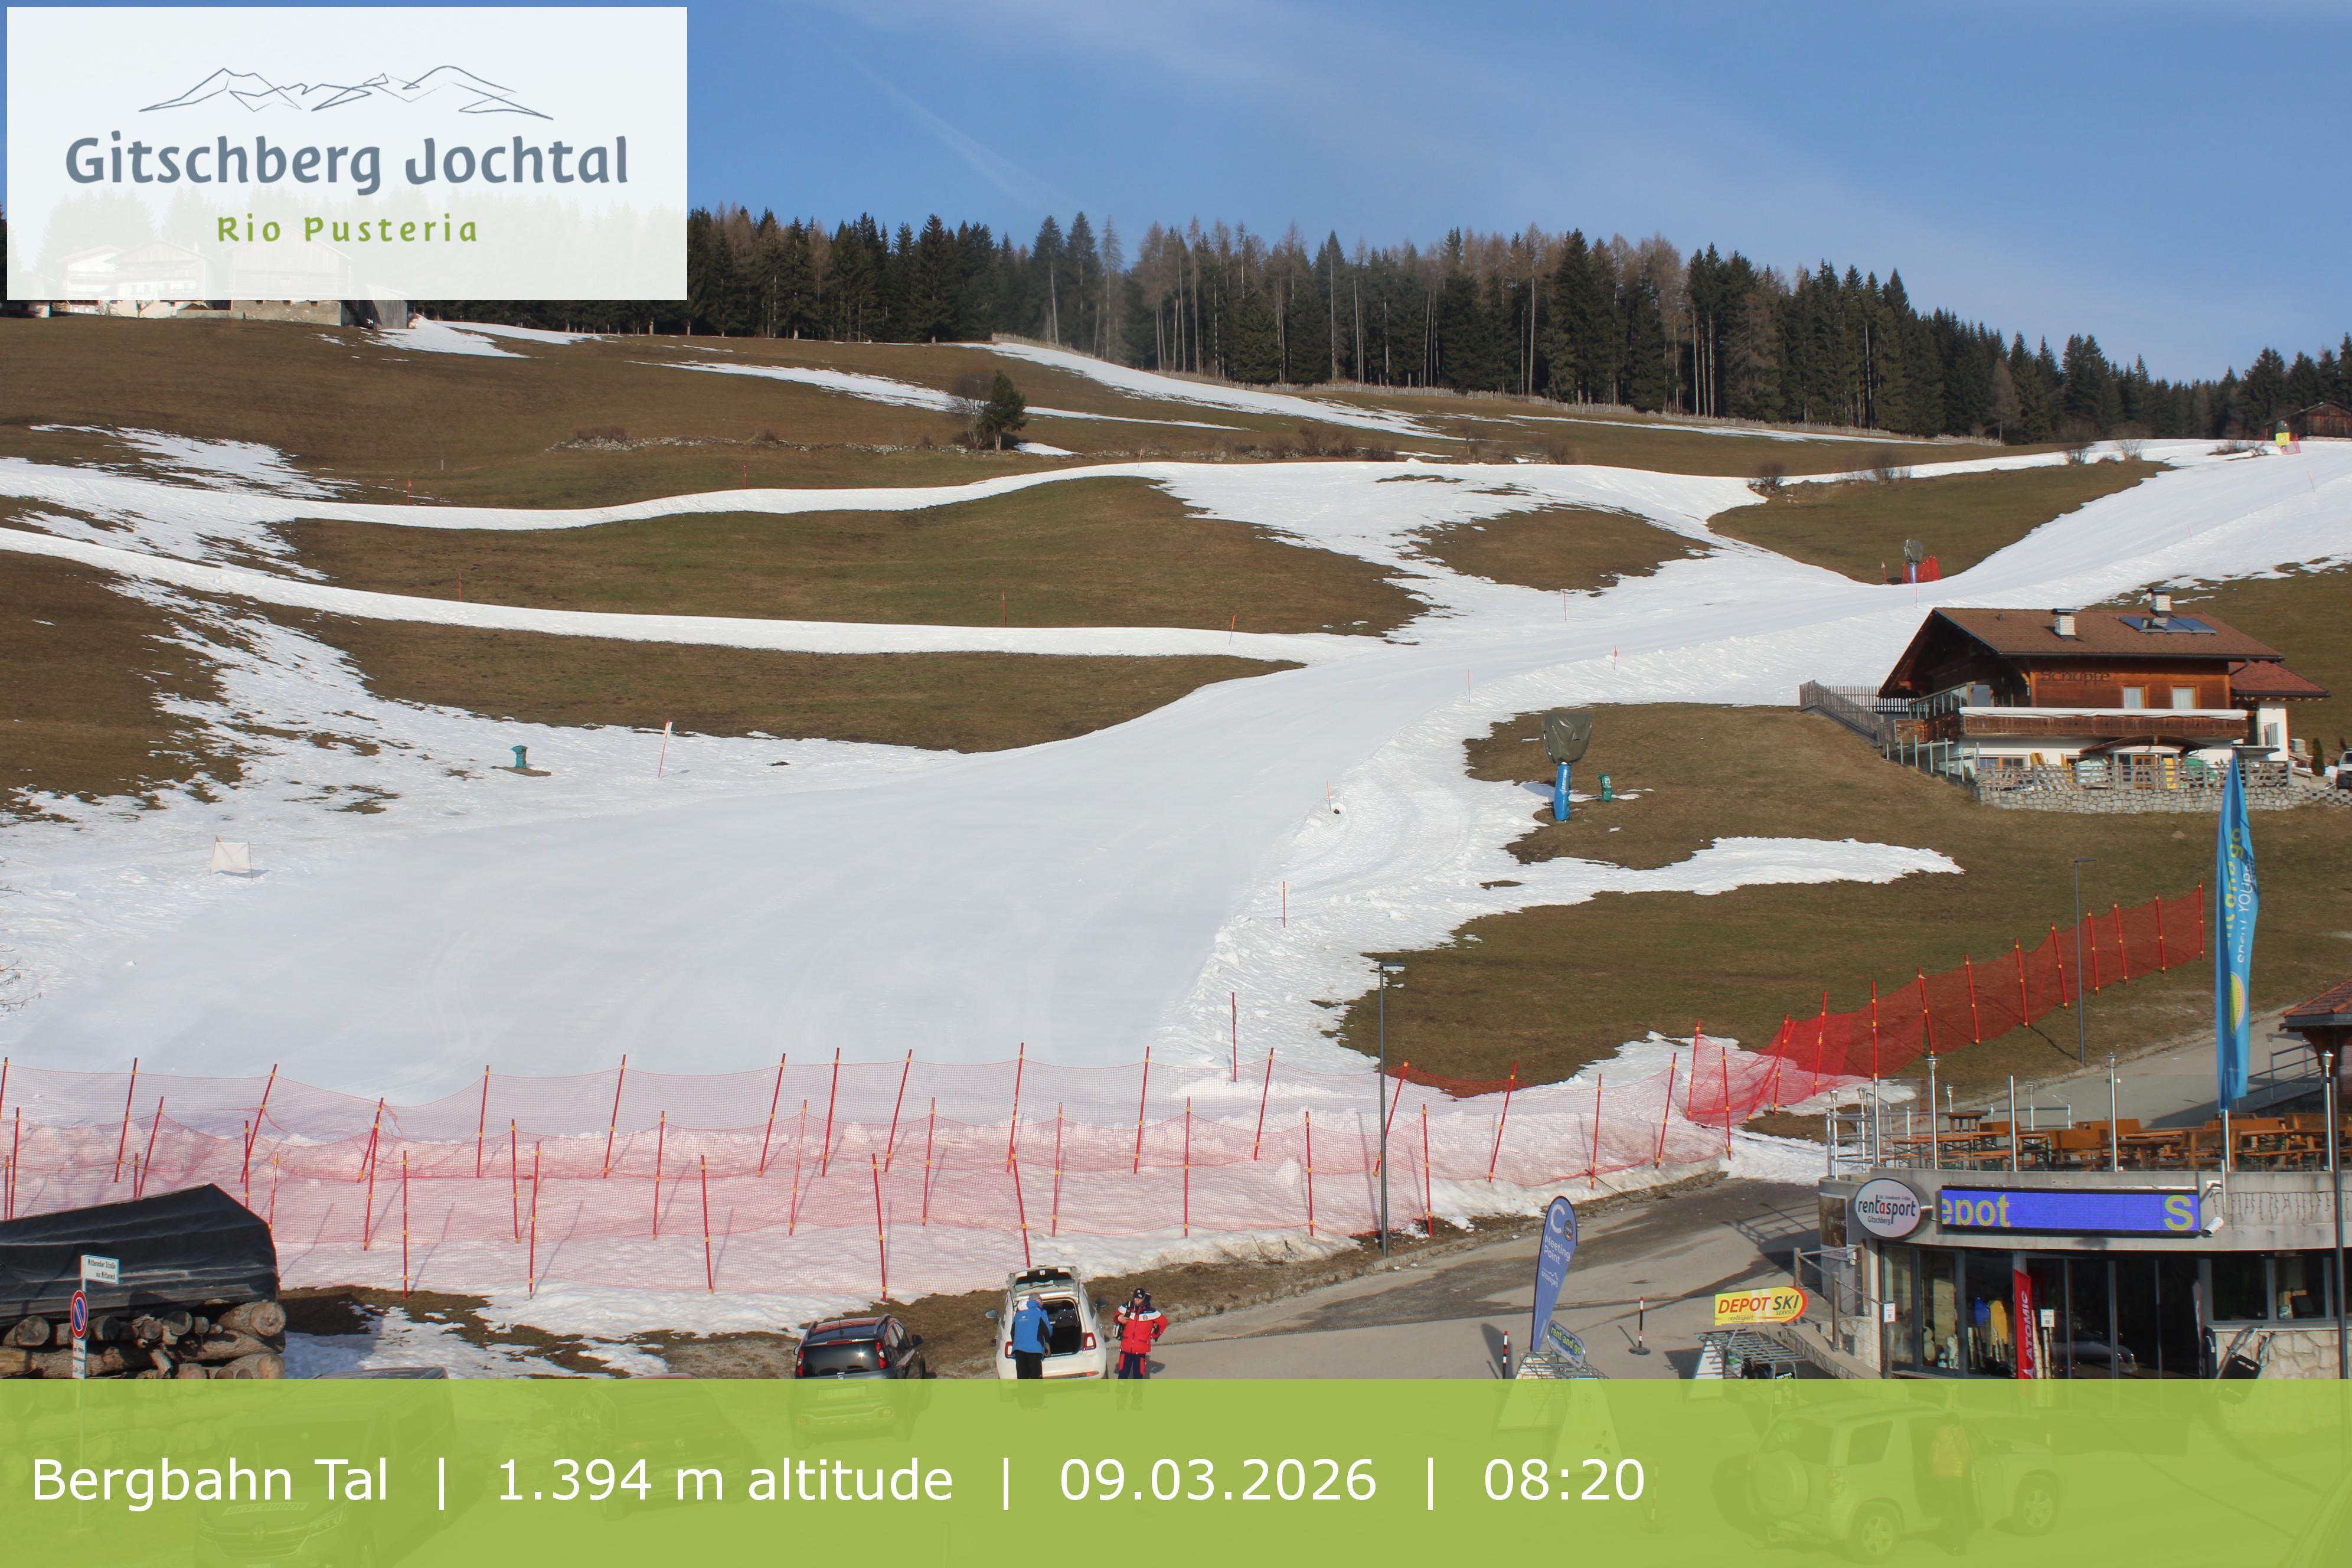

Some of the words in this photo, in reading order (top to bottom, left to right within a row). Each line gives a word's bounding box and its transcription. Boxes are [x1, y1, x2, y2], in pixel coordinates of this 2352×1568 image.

[1858, 1194, 1916, 1224] rentasport
[1867, 1216, 1891, 1226] Gitschberg
[2163, 1195, 2194, 1231] S
[1544, 1236, 1571, 1262] Meeting
[1544, 1245, 1560, 1265] Point
[1718, 1296, 1771, 1314] DEPOT
[1772, 1294, 1799, 1311] SKI
[2021, 1290, 2033, 1361] ATOMIC
[1551, 1327, 1562, 1340] rent
[1562, 1335, 1574, 1348] and
[1573, 1344, 1582, 1355] go
